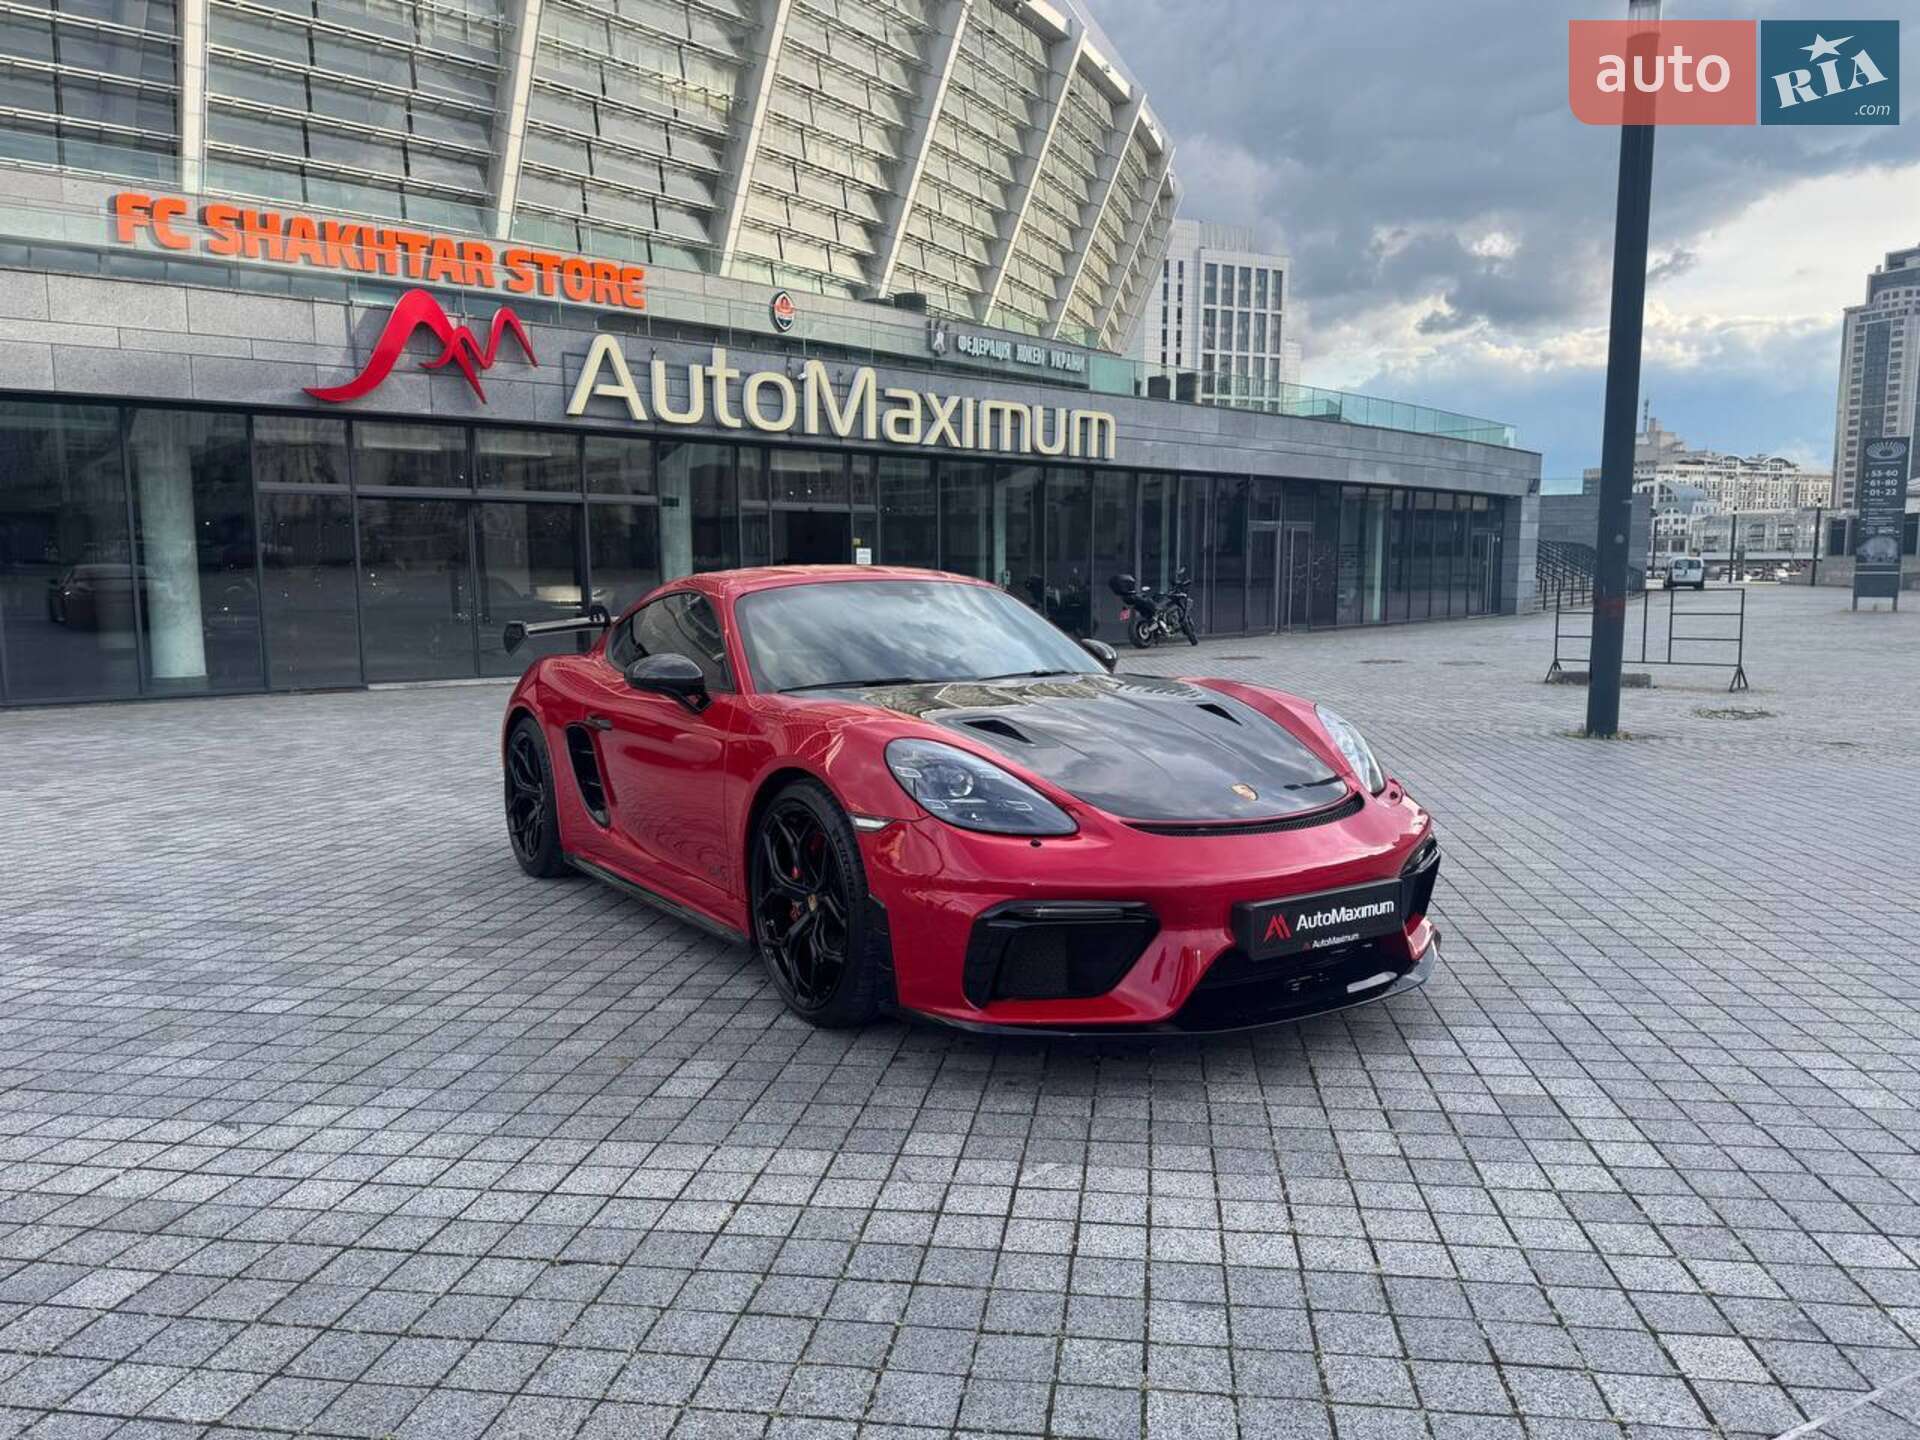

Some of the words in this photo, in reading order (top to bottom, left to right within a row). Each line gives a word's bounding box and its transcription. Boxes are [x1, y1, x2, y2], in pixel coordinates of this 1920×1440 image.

[114, 192, 191, 250] FC
[202, 203, 495, 288] SHAKHTAR
[505, 249, 645, 309] STORE
[566, 333, 1117, 460] AutoMaximum
[1296, 900, 1395, 931] AutoMaximum
[1312, 932, 1360, 949] AutoMaximum
